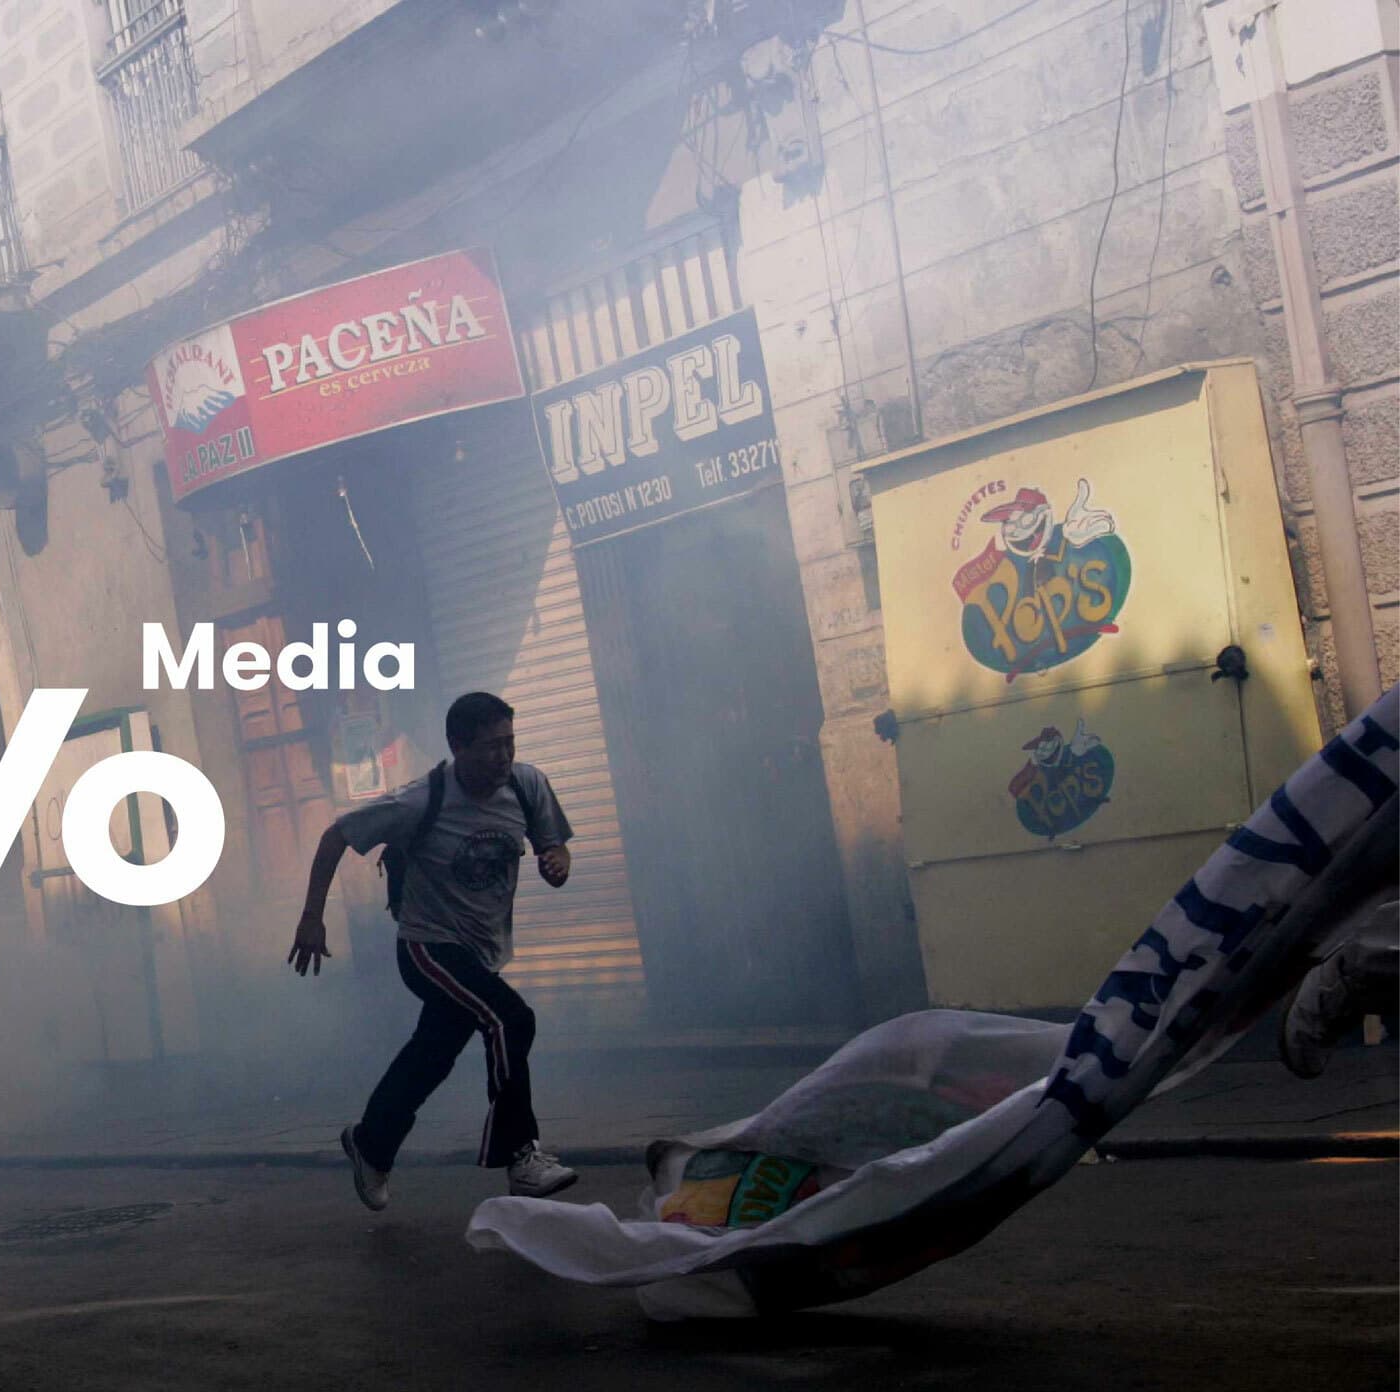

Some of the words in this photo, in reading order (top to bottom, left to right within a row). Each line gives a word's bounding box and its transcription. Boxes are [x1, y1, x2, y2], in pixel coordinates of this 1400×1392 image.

[262, 288, 486, 394] PACEÑA
[319, 381, 342, 397] es
[347, 357, 433, 390] cerveza
[544, 334, 763, 485] INPEL
[198, 433, 237, 475] PAZ
[951, 479, 1007, 551] CHUPETES
